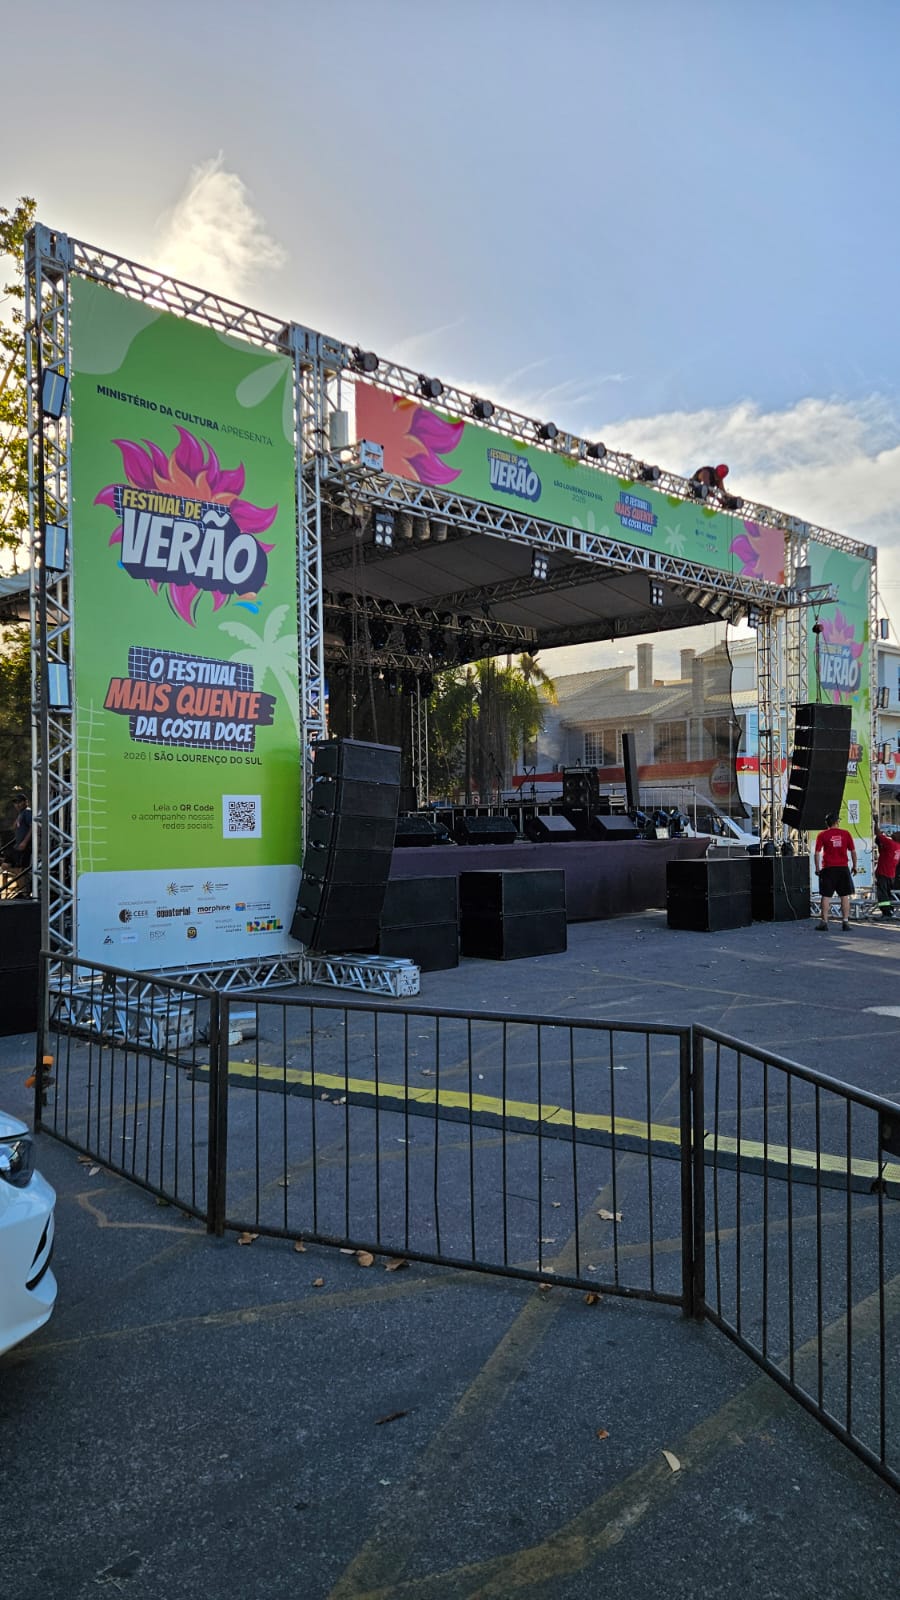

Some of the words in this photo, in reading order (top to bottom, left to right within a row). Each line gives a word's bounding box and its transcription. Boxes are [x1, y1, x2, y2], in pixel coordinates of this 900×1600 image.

[97, 385, 157, 411] MINISTÉRIO
[160, 405, 173, 416] DA
[175, 410, 219, 431] CULTURA
[221, 424, 273, 446] APRESENTA
[490, 459, 538, 496] VERÃO
[122, 489, 181, 517] FESTIVAL
[184, 502, 201, 520] DE
[615, 503, 631, 517] MAIS
[122, 508, 258, 584] VERÃO
[150, 656, 164, 679] O
[167, 659, 237, 686] FESTIVAL
[105, 679, 171, 713] MAIS
[176, 686, 261, 719] QUENTE
[135, 716, 157, 737] DA
[161, 717, 211, 740] COSTA
[214, 722, 254, 742] DOCE
[154, 751, 174, 761] SÃO
[176, 753, 227, 765] LOURENÇO
[230, 756, 243, 764] DO
[245, 757, 262, 765] SUL
[139, 813, 186, 822] acompanhe
[153, 803, 171, 811] Leia
[180, 804, 192, 812] QR
[193, 803, 214, 811] Code
[162, 822, 185, 830] redes
[156, 906, 191, 918] equatorial
[197, 904, 230, 913] morphine
